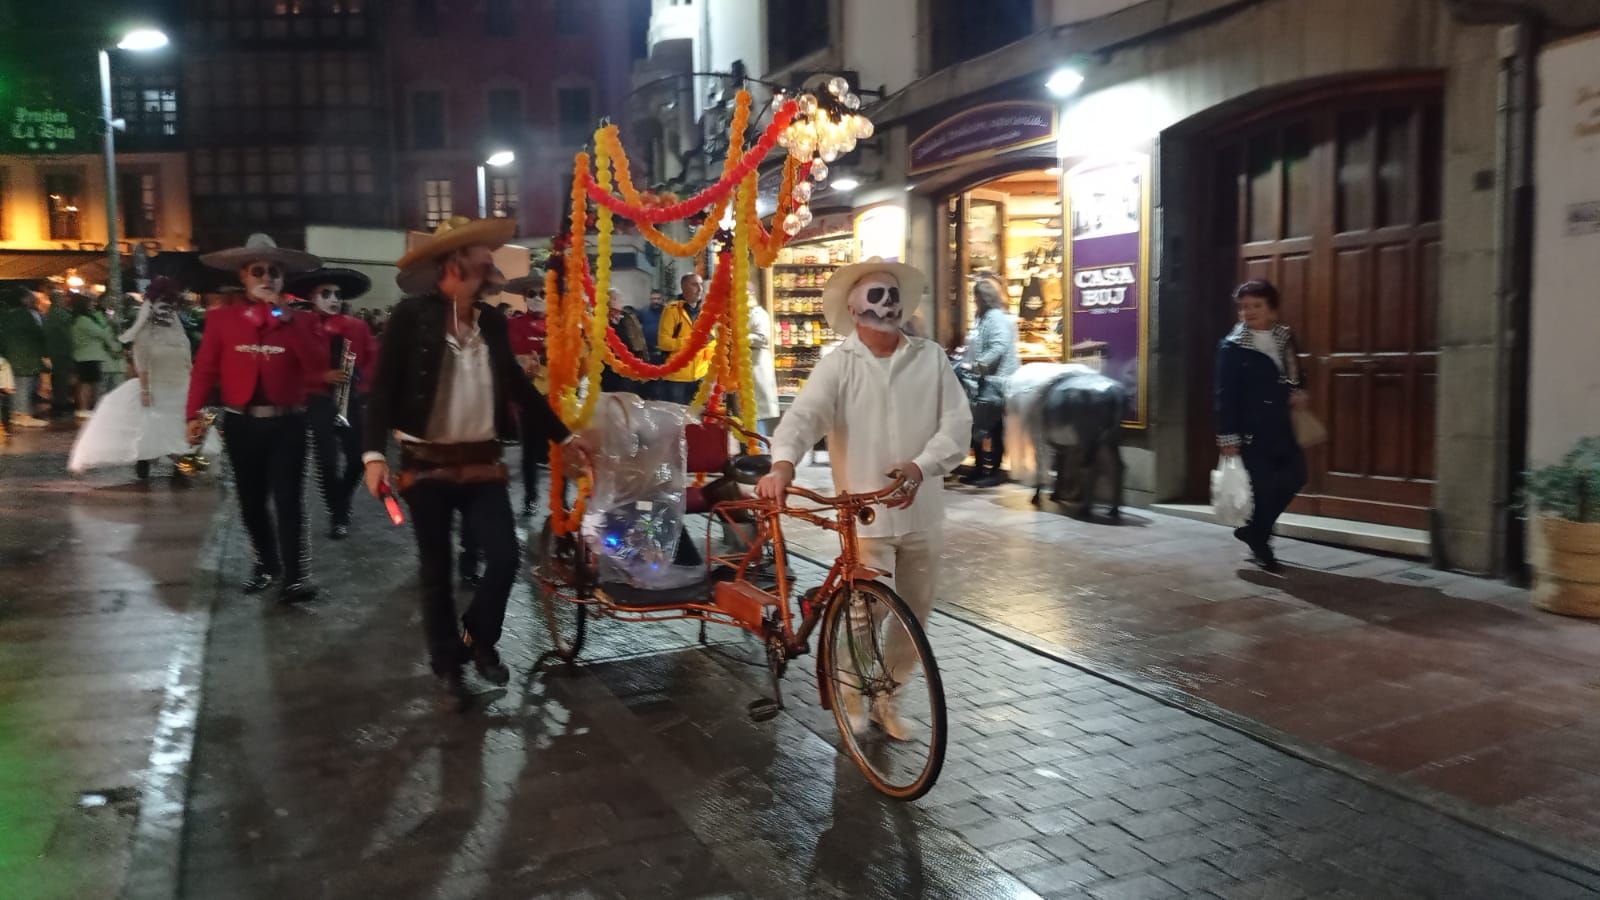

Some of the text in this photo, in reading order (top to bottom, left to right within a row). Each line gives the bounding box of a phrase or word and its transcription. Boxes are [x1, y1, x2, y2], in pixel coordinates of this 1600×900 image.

[11, 123, 36, 139] La
[1074, 266, 1136, 289] CASA
[1080, 287, 1129, 307] BUJ
